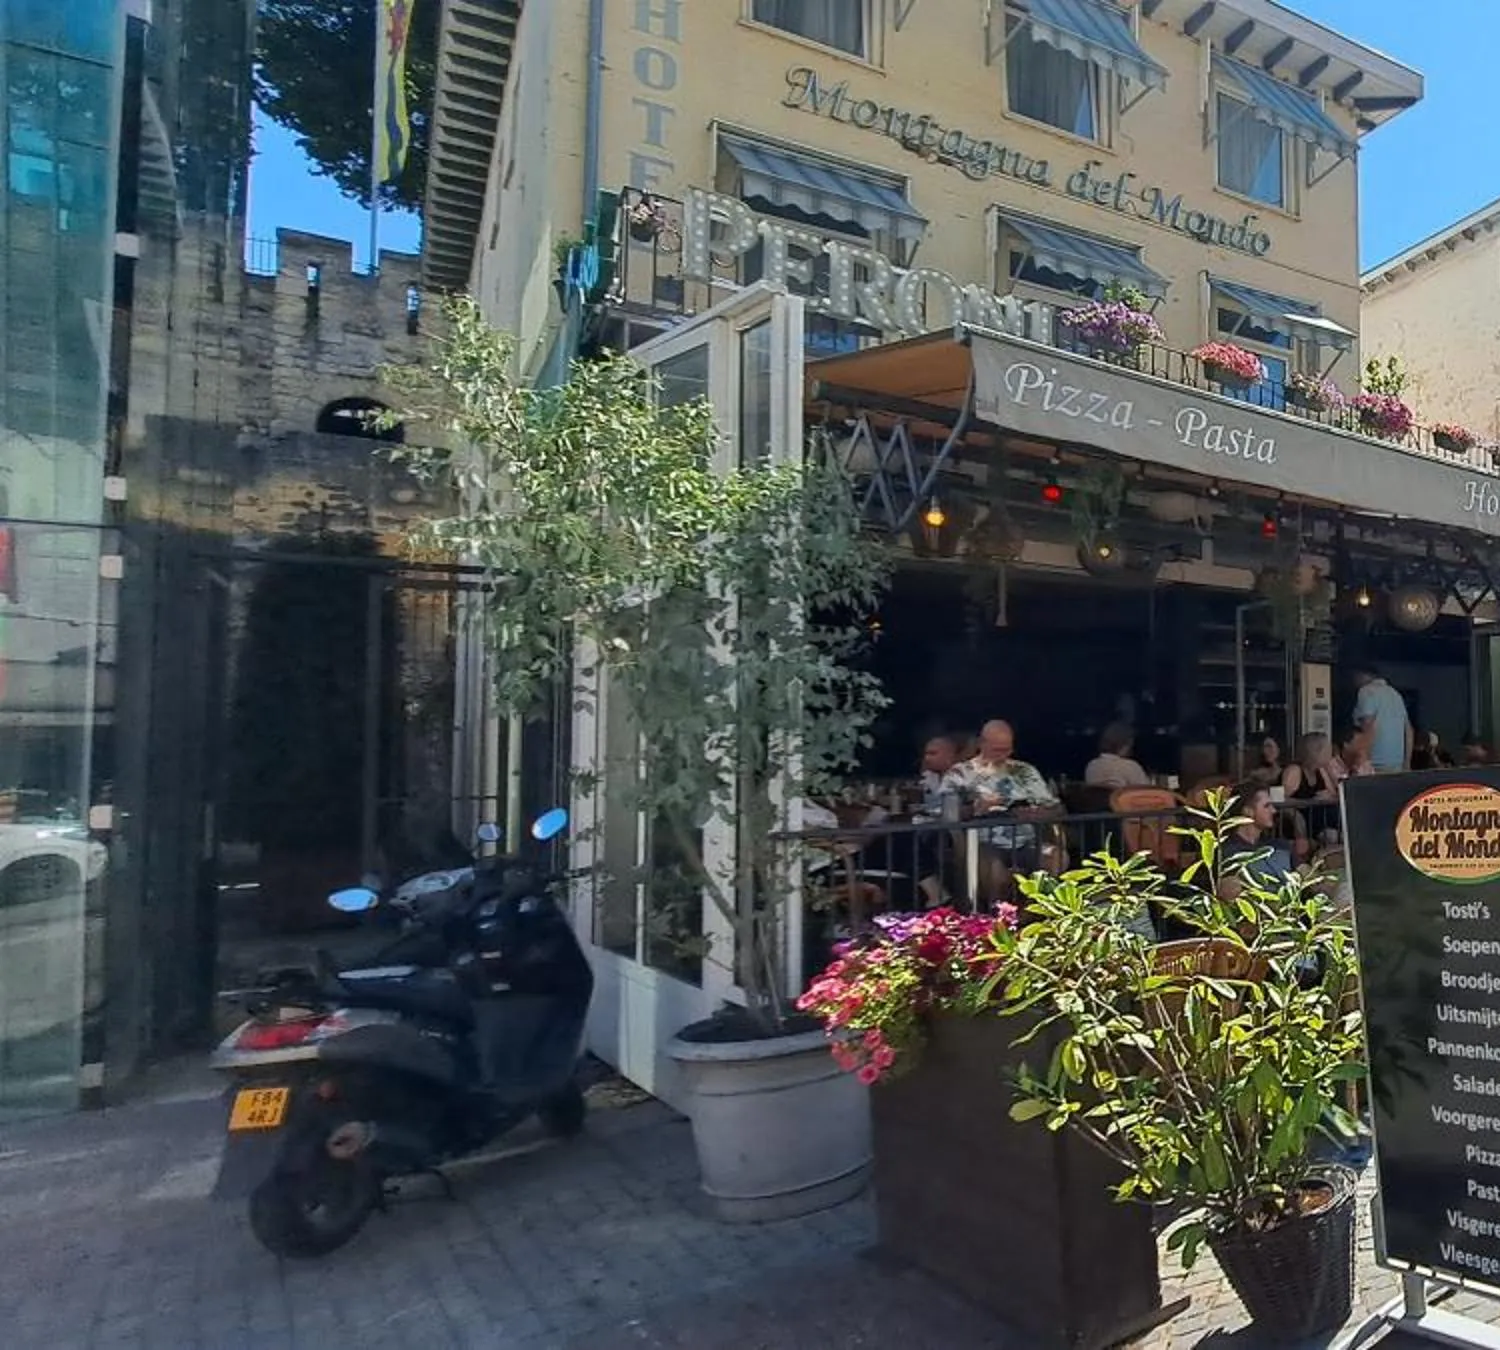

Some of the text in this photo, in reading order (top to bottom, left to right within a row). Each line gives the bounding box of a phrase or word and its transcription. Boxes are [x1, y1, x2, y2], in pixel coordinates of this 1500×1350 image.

[629, 0, 682, 240] HOTE
[781, 64, 1271, 256] Montagna del Mondo
[682, 186, 1056, 345] PERONI
[1004, 363, 1132, 430] Pizza
[1175, 407, 1278, 465] Pasta
[1410, 835, 1441, 859] del
[1442, 901, 1491, 920] Tosti's
[1443, 935, 1500, 957] Soepen
